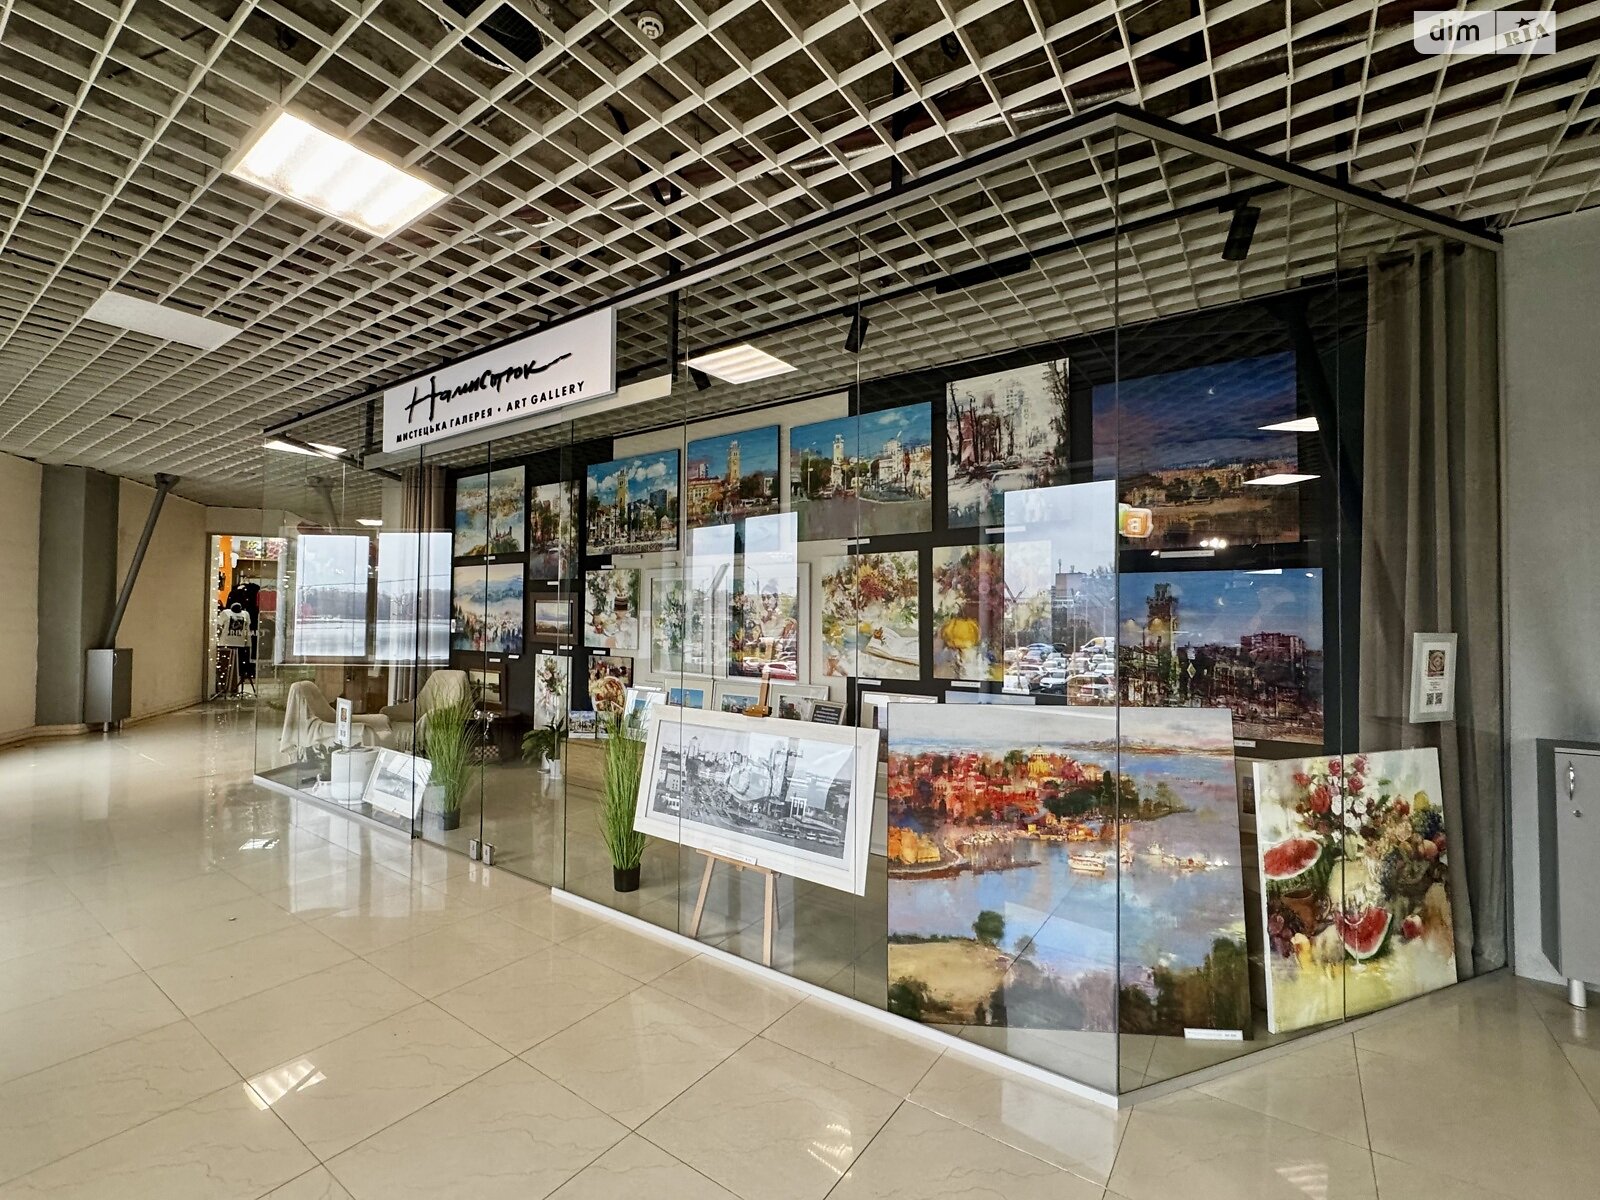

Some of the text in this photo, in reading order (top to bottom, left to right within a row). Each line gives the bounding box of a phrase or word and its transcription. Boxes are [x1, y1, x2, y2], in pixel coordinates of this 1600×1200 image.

[396, 381, 585, 443] МИСТЕЦЬКА ГАЛЕРЕЯ ART GALLERY
